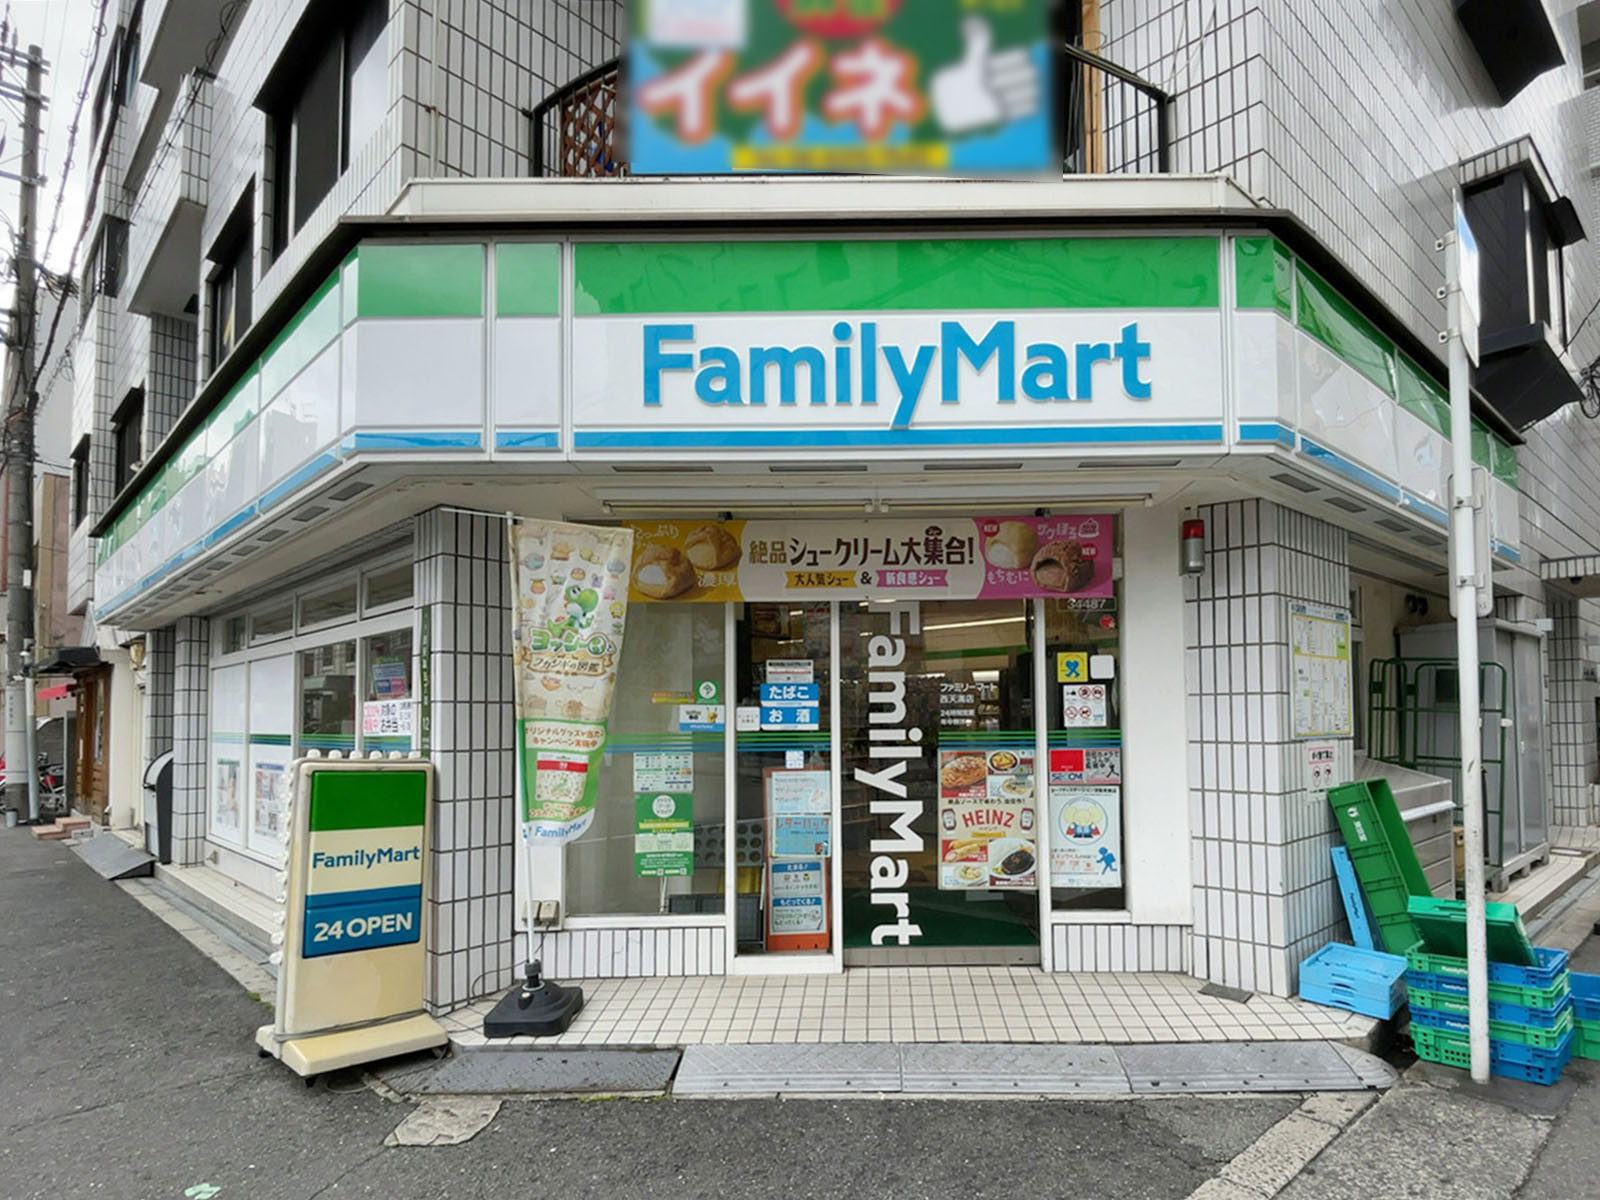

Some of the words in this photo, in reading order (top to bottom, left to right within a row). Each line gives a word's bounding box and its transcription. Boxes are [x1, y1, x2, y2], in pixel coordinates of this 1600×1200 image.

[637, 36, 926, 144] イイネ
[642, 321, 1152, 430] FamilyMart
[794, 572, 849, 586] 大人気シュー
[860, 571, 872, 584] &
[769, 685, 810, 700] たばこ
[853, 600, 925, 946] FamilyMart
[962, 808, 1015, 828] HEINZ
[312, 846, 421, 869] FamilyMart
[313, 921, 344, 942] 24
[346, 912, 413, 938] OPEN
